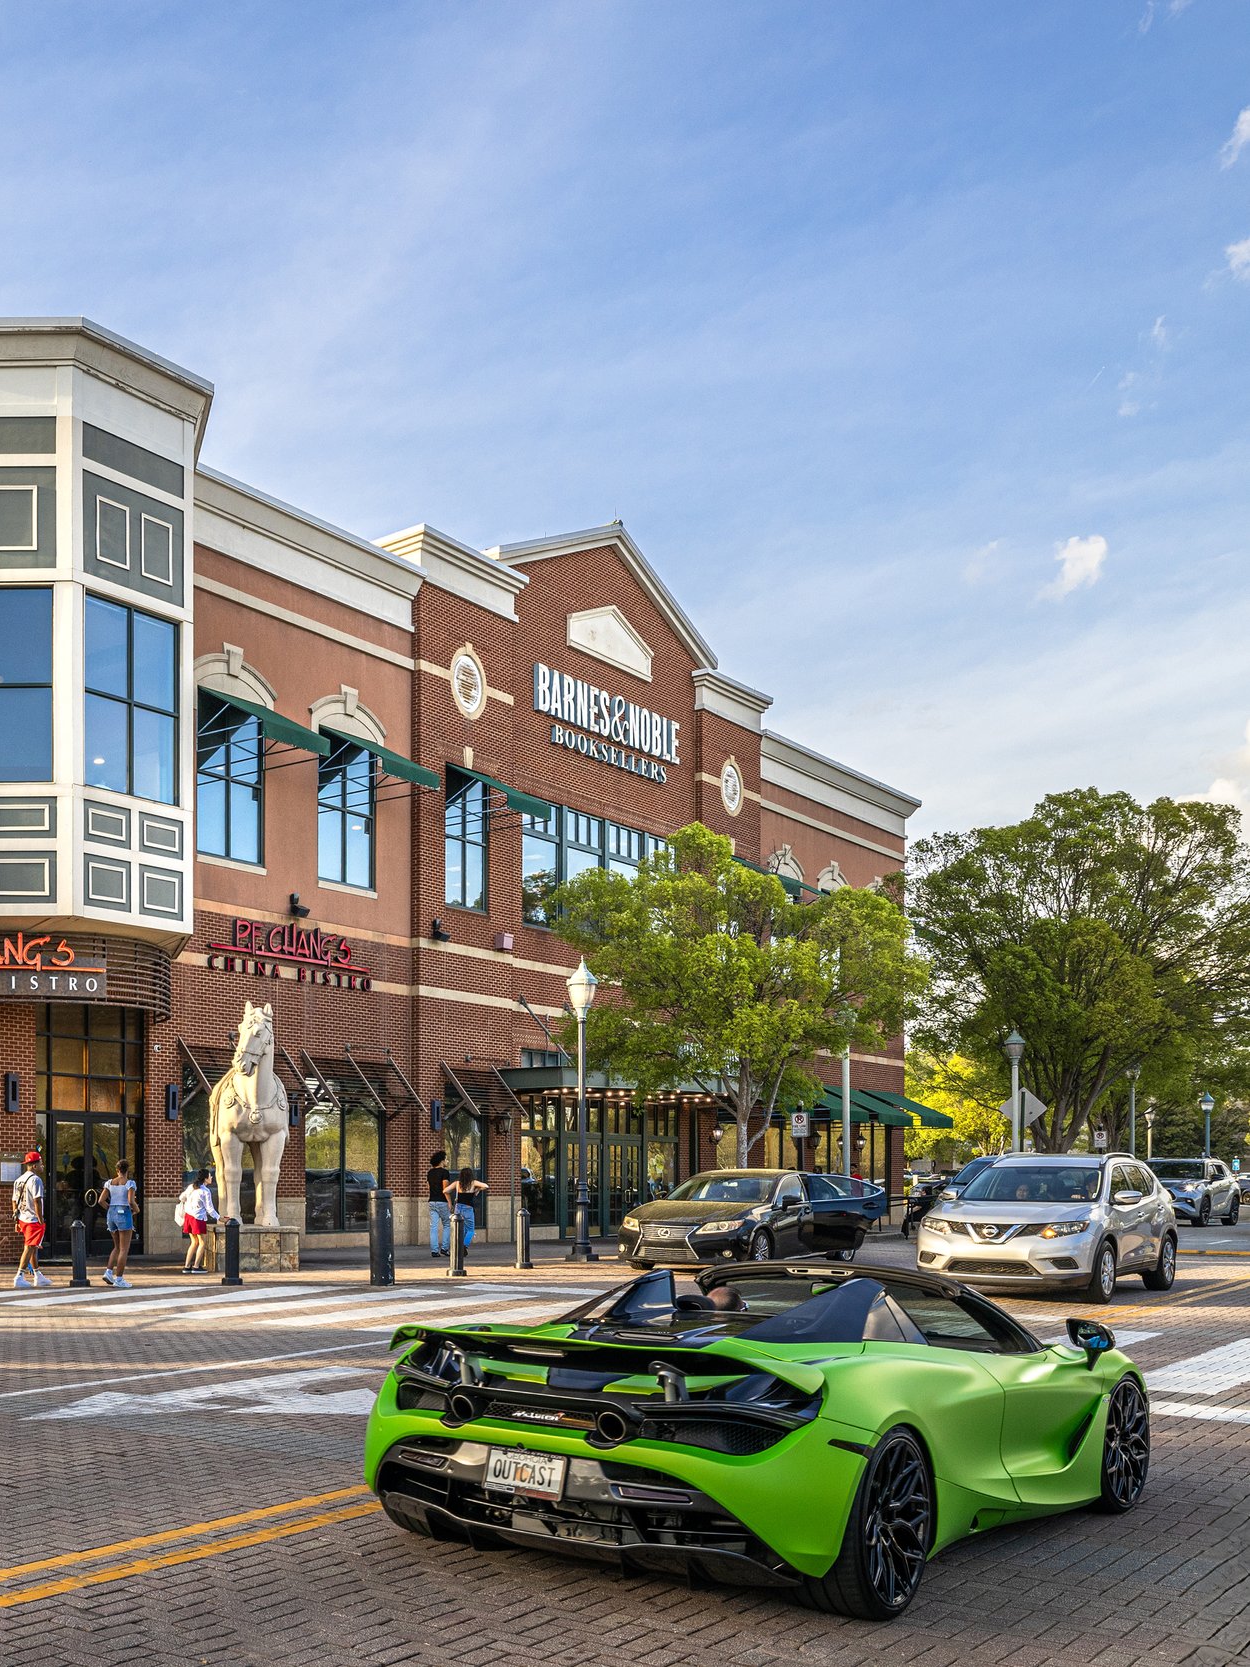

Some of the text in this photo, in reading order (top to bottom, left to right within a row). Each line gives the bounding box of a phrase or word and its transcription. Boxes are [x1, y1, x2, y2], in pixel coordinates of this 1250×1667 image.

[551, 724, 668, 784] BOOKSELLERS
[207, 953, 373, 992] CHINA BISTRO
[493, 1458, 556, 1488] OUTCAST
